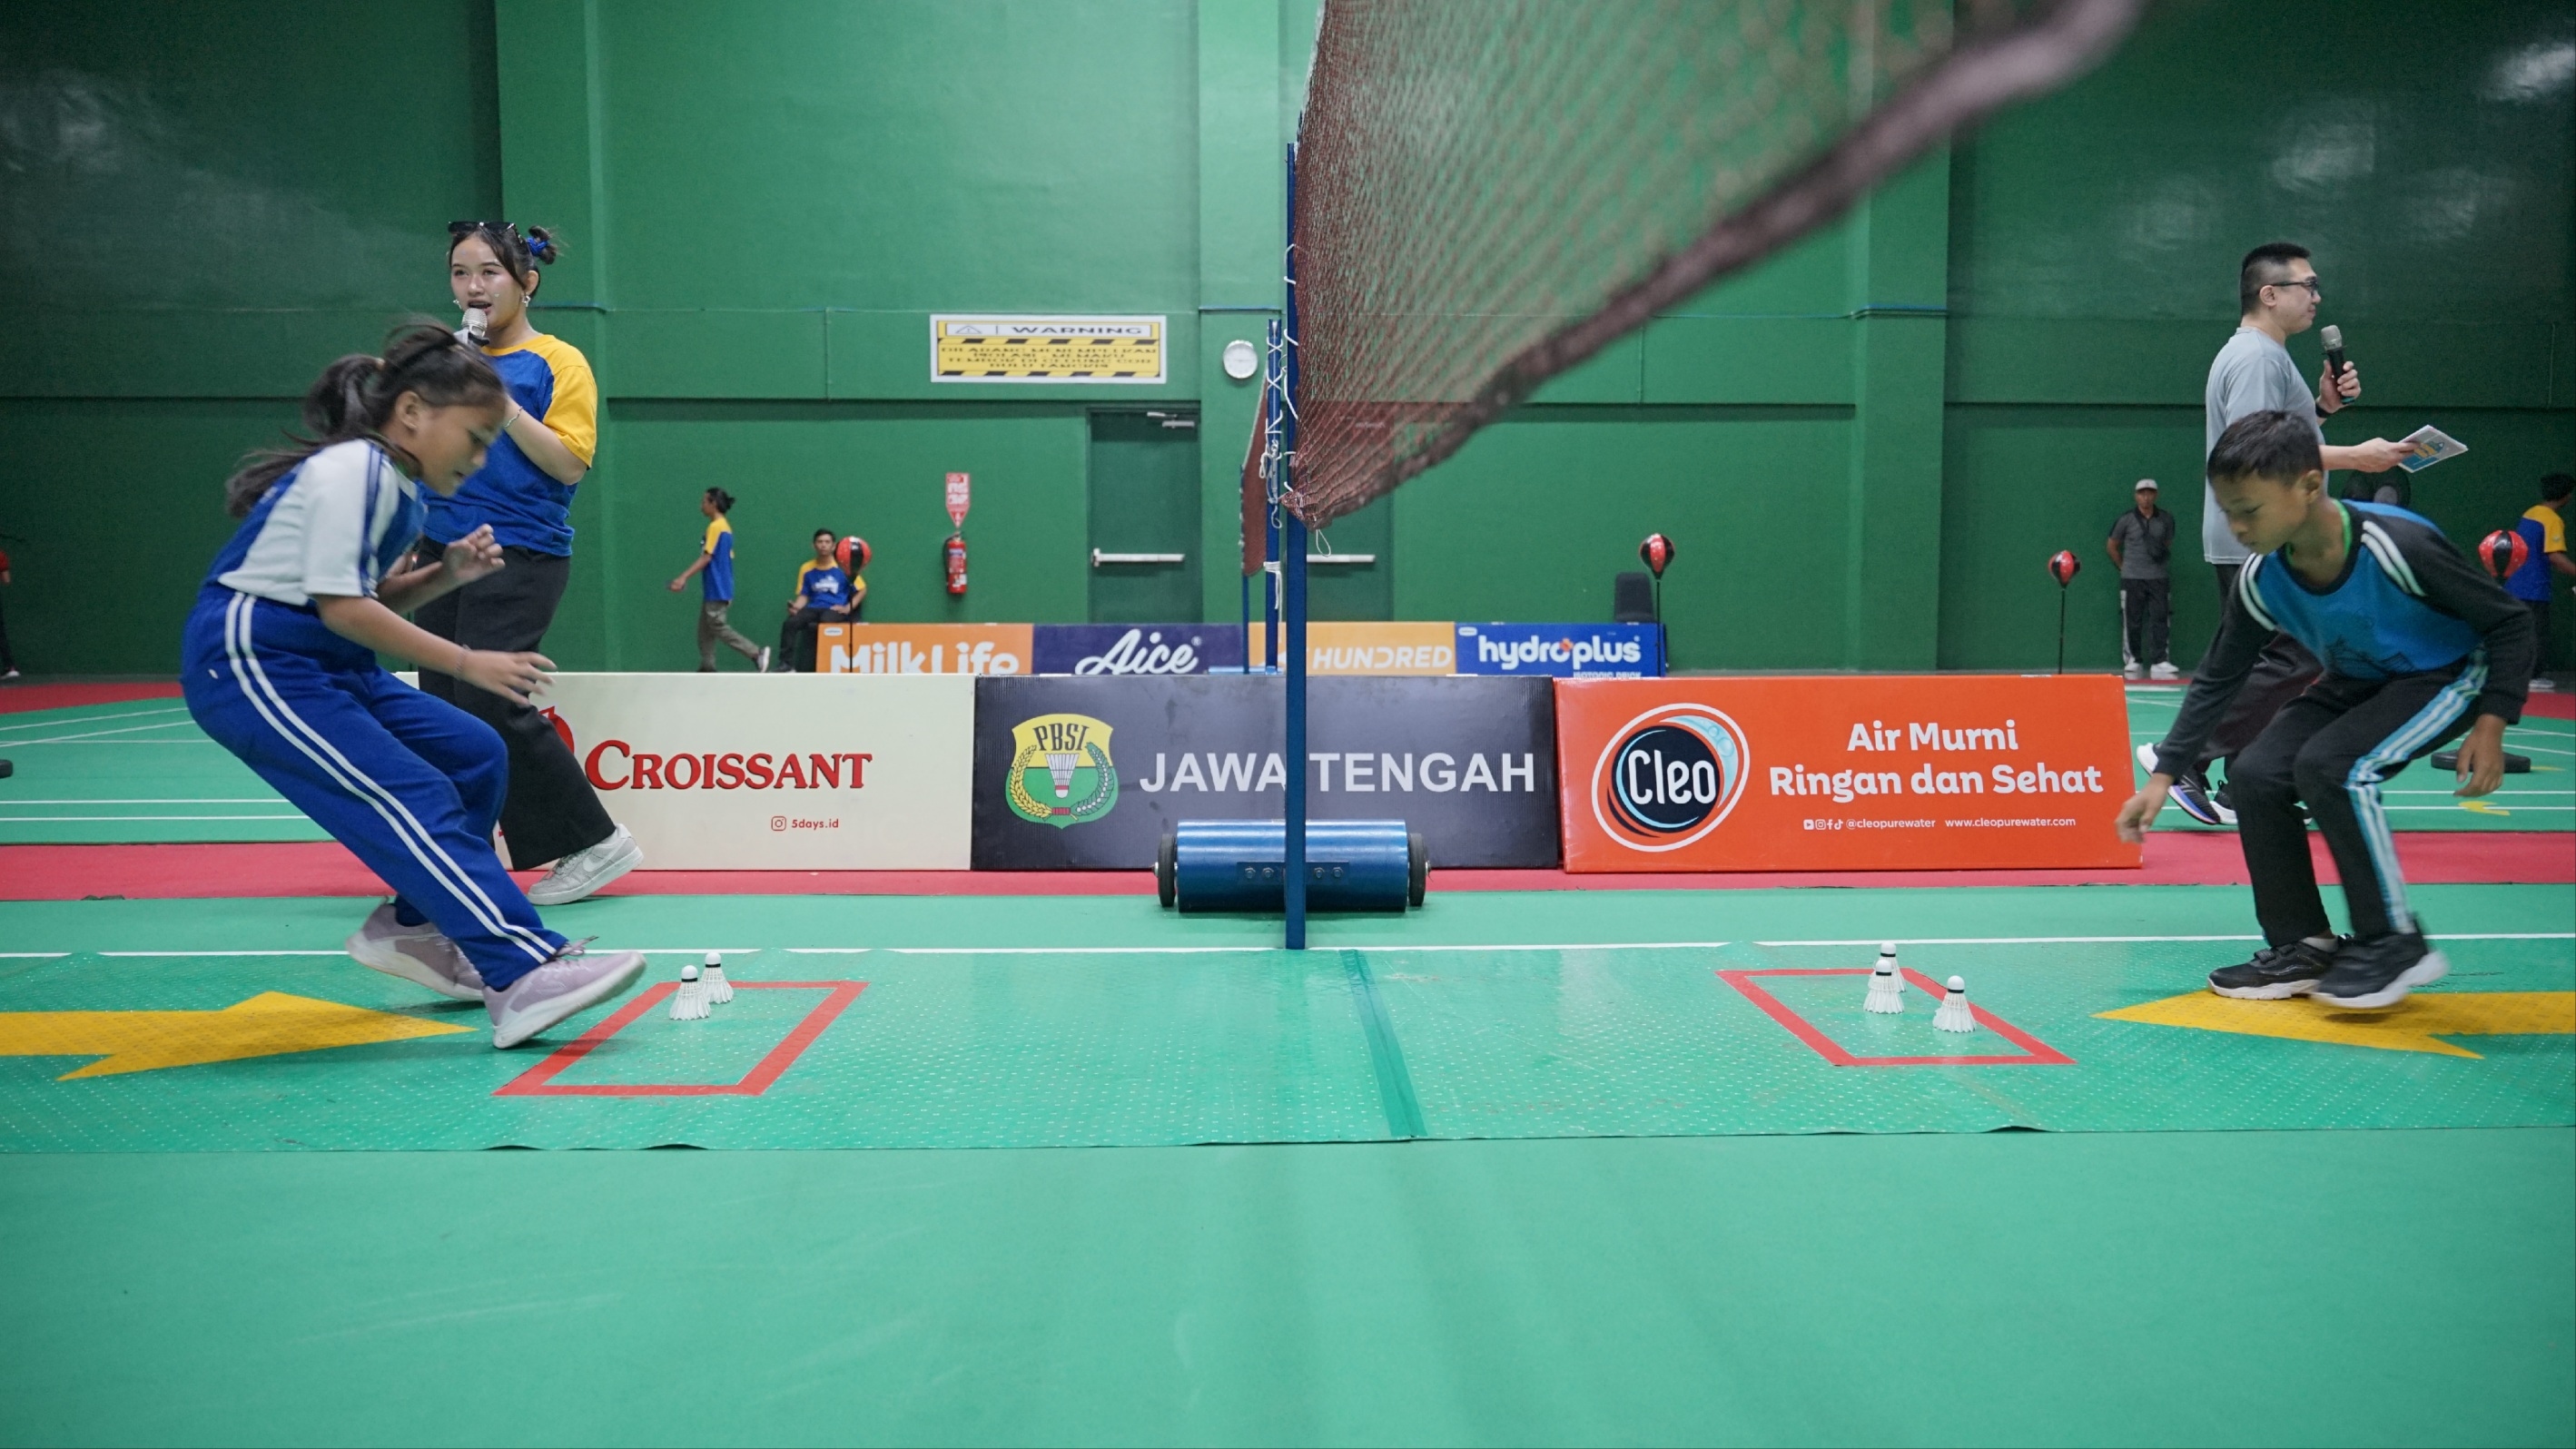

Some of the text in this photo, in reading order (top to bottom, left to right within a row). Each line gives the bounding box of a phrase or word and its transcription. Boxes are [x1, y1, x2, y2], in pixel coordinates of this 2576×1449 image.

[1011, 326, 1143, 335] WARNING
[1074, 628, 1199, 675] Aice
[1312, 646, 1453, 669] HUNDRED
[1478, 635, 1642, 670] hydroplus
[1033, 724, 1088, 752] PBSI
[1847, 719, 2018, 752] Air Murni
[585, 739, 873, 791] CROISSANT
[1140, 753, 1535, 793] JAWA TENGAH
[1626, 749, 1715, 805] Cleo
[1770, 763, 2104, 803] Ringan dan Sehat
[791, 817, 839, 830] 5days.id
[1846, 817, 2077, 831] @cleopurewater www.cleopurewater.com
